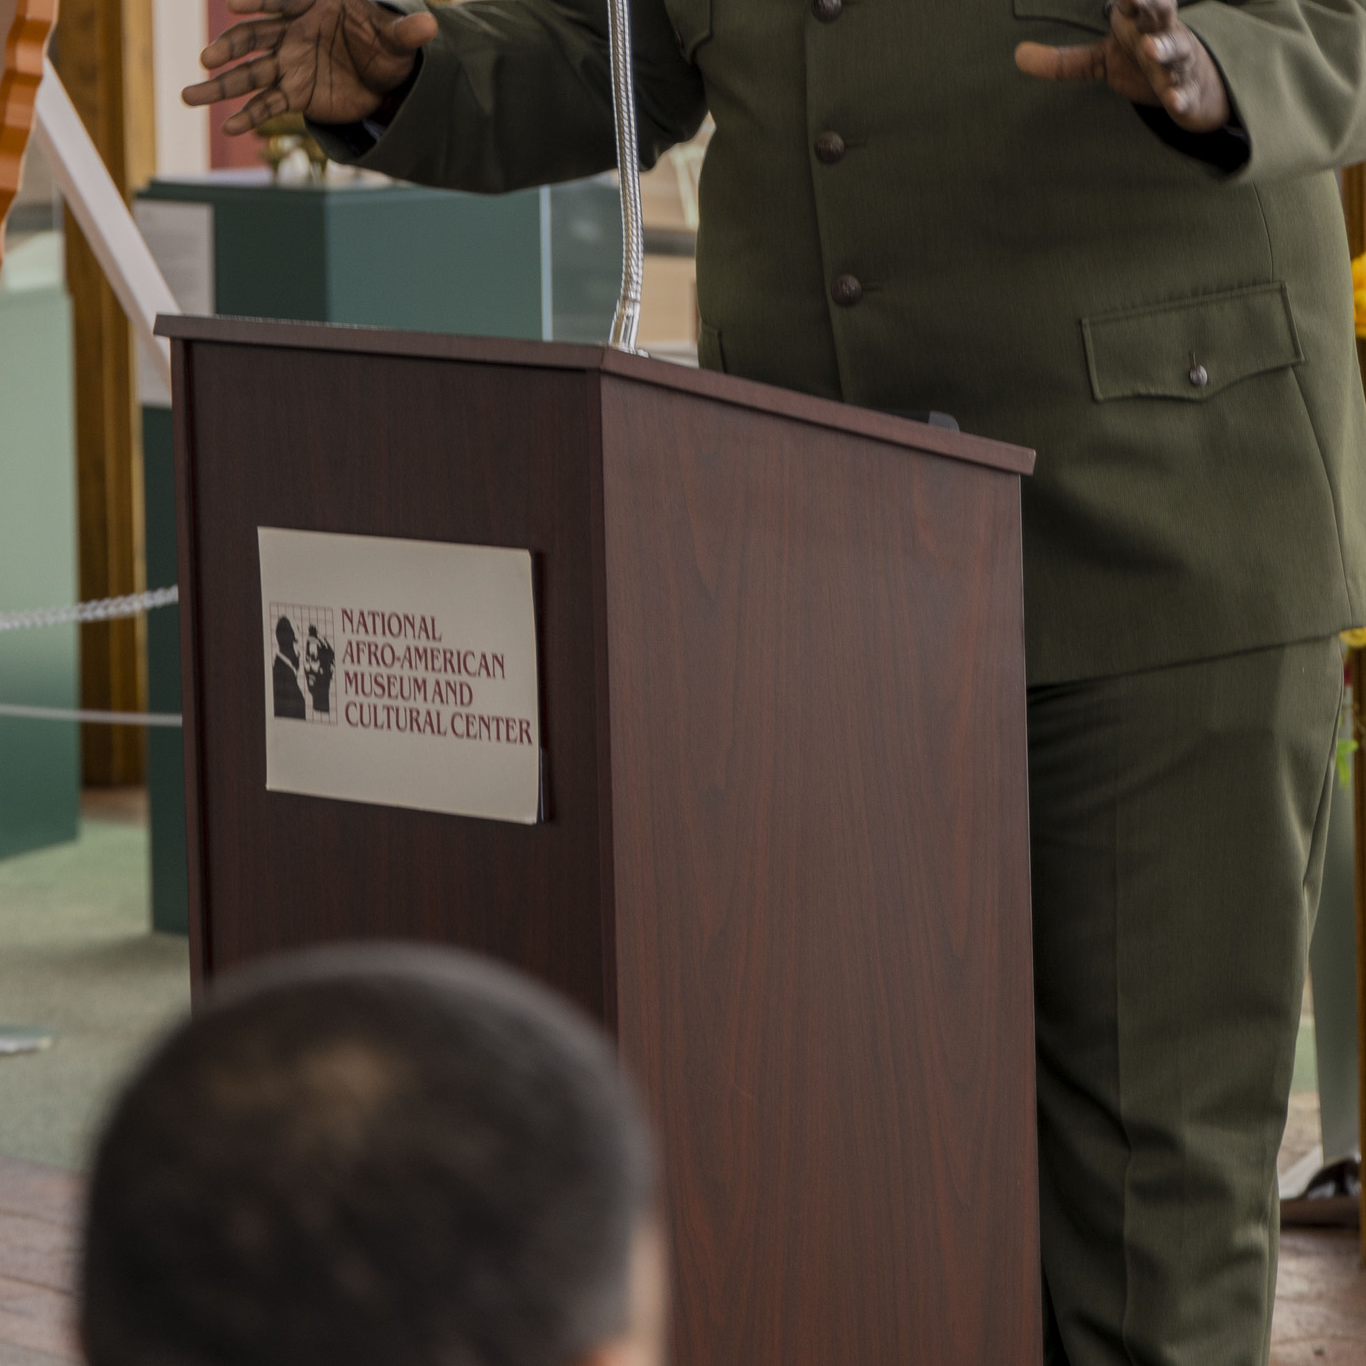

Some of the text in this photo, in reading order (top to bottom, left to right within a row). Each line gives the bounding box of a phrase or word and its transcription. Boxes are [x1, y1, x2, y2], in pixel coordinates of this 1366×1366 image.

[341, 608, 442, 642] NATIONAL
[342, 639, 506, 679] AFRO-AMERICAN
[344, 669, 473, 708] MUSEUM AND
[345, 700, 533, 746] CULTURAL CENTER
